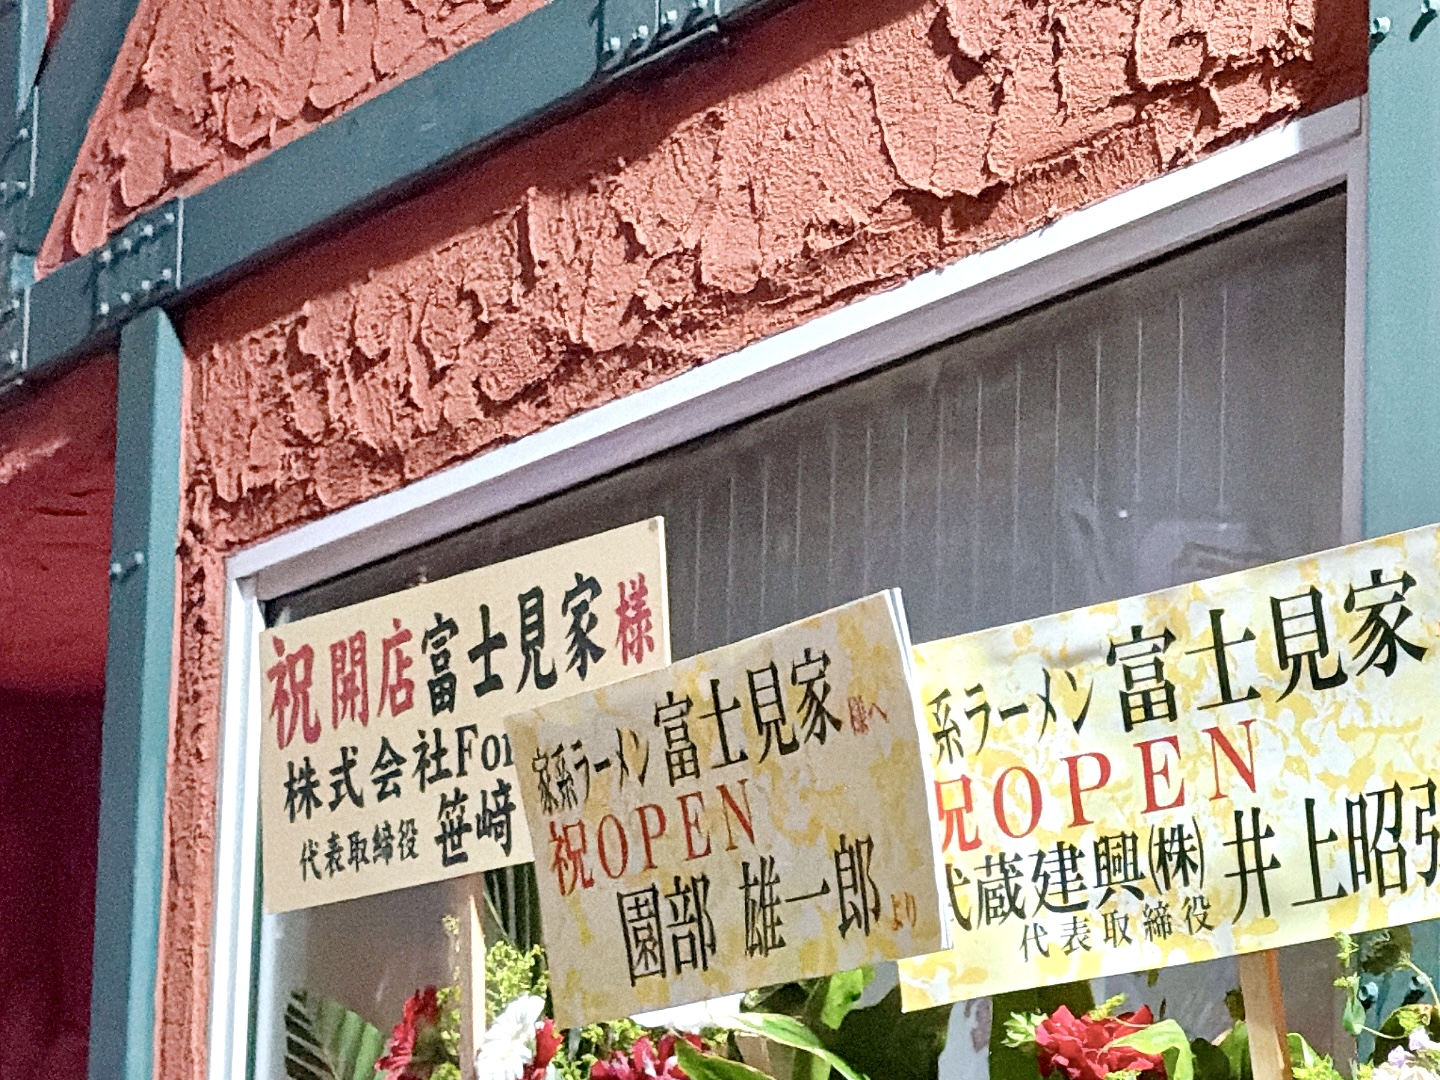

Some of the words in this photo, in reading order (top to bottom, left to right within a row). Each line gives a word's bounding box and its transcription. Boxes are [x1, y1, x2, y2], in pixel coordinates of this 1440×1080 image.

[616, 872, 717, 987] 園部
[1019, 894, 1216, 962] 代表取締役
